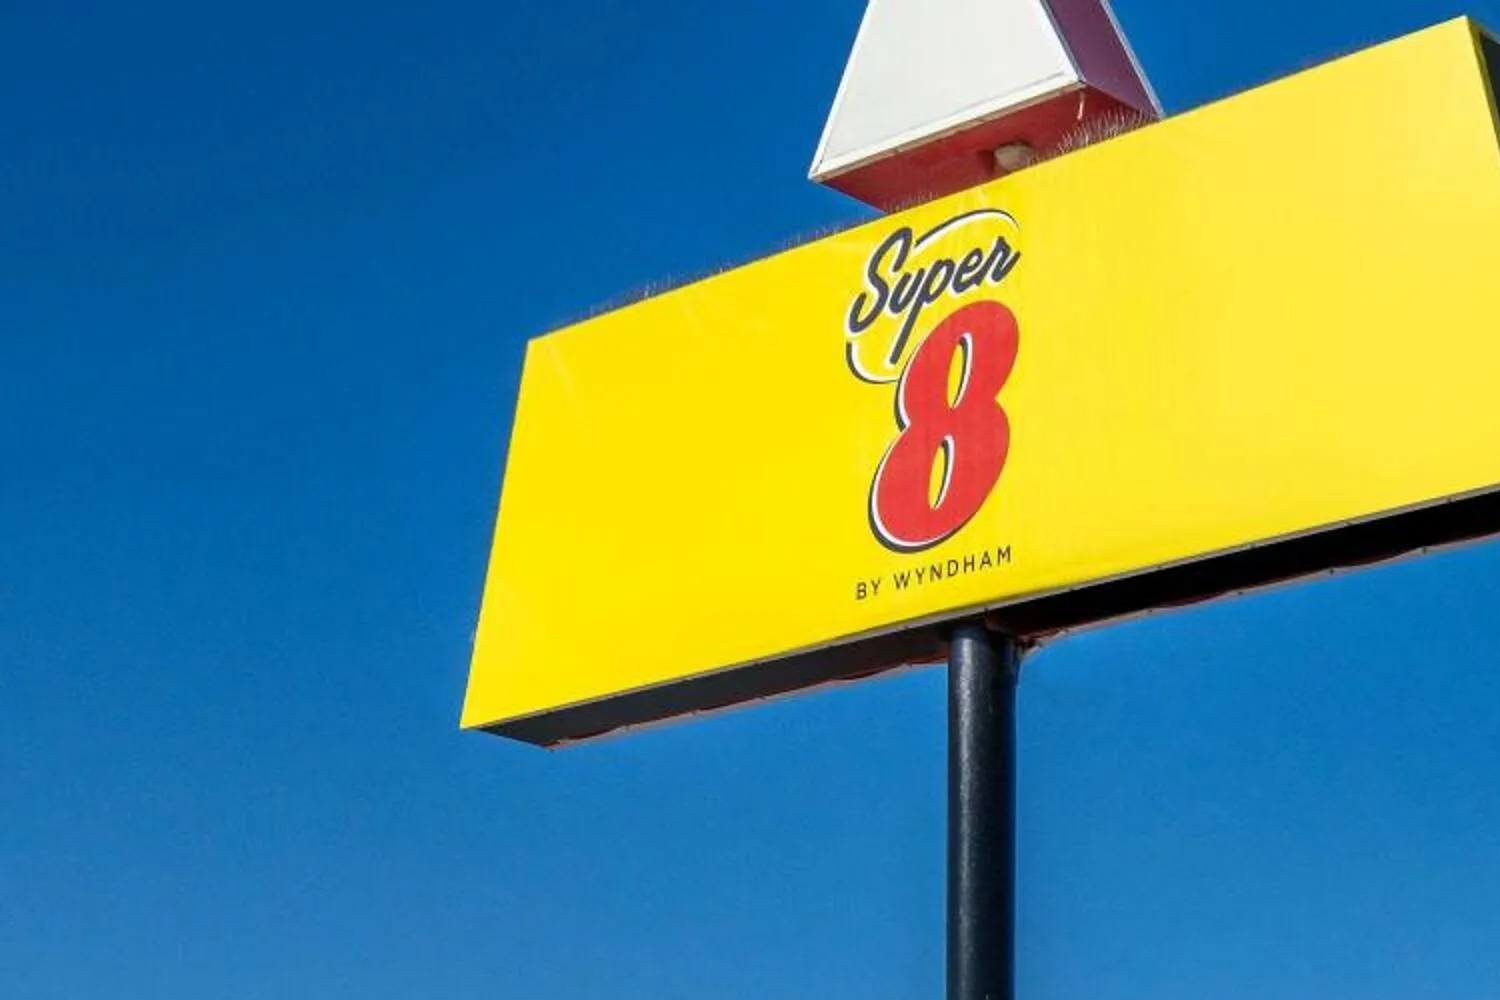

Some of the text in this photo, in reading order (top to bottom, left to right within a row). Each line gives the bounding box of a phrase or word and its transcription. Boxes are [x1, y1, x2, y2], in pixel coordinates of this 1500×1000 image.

[849, 226, 1019, 364] Super
[868, 300, 1019, 554] 8
[856, 544, 1011, 600] BY WYNDHAM
